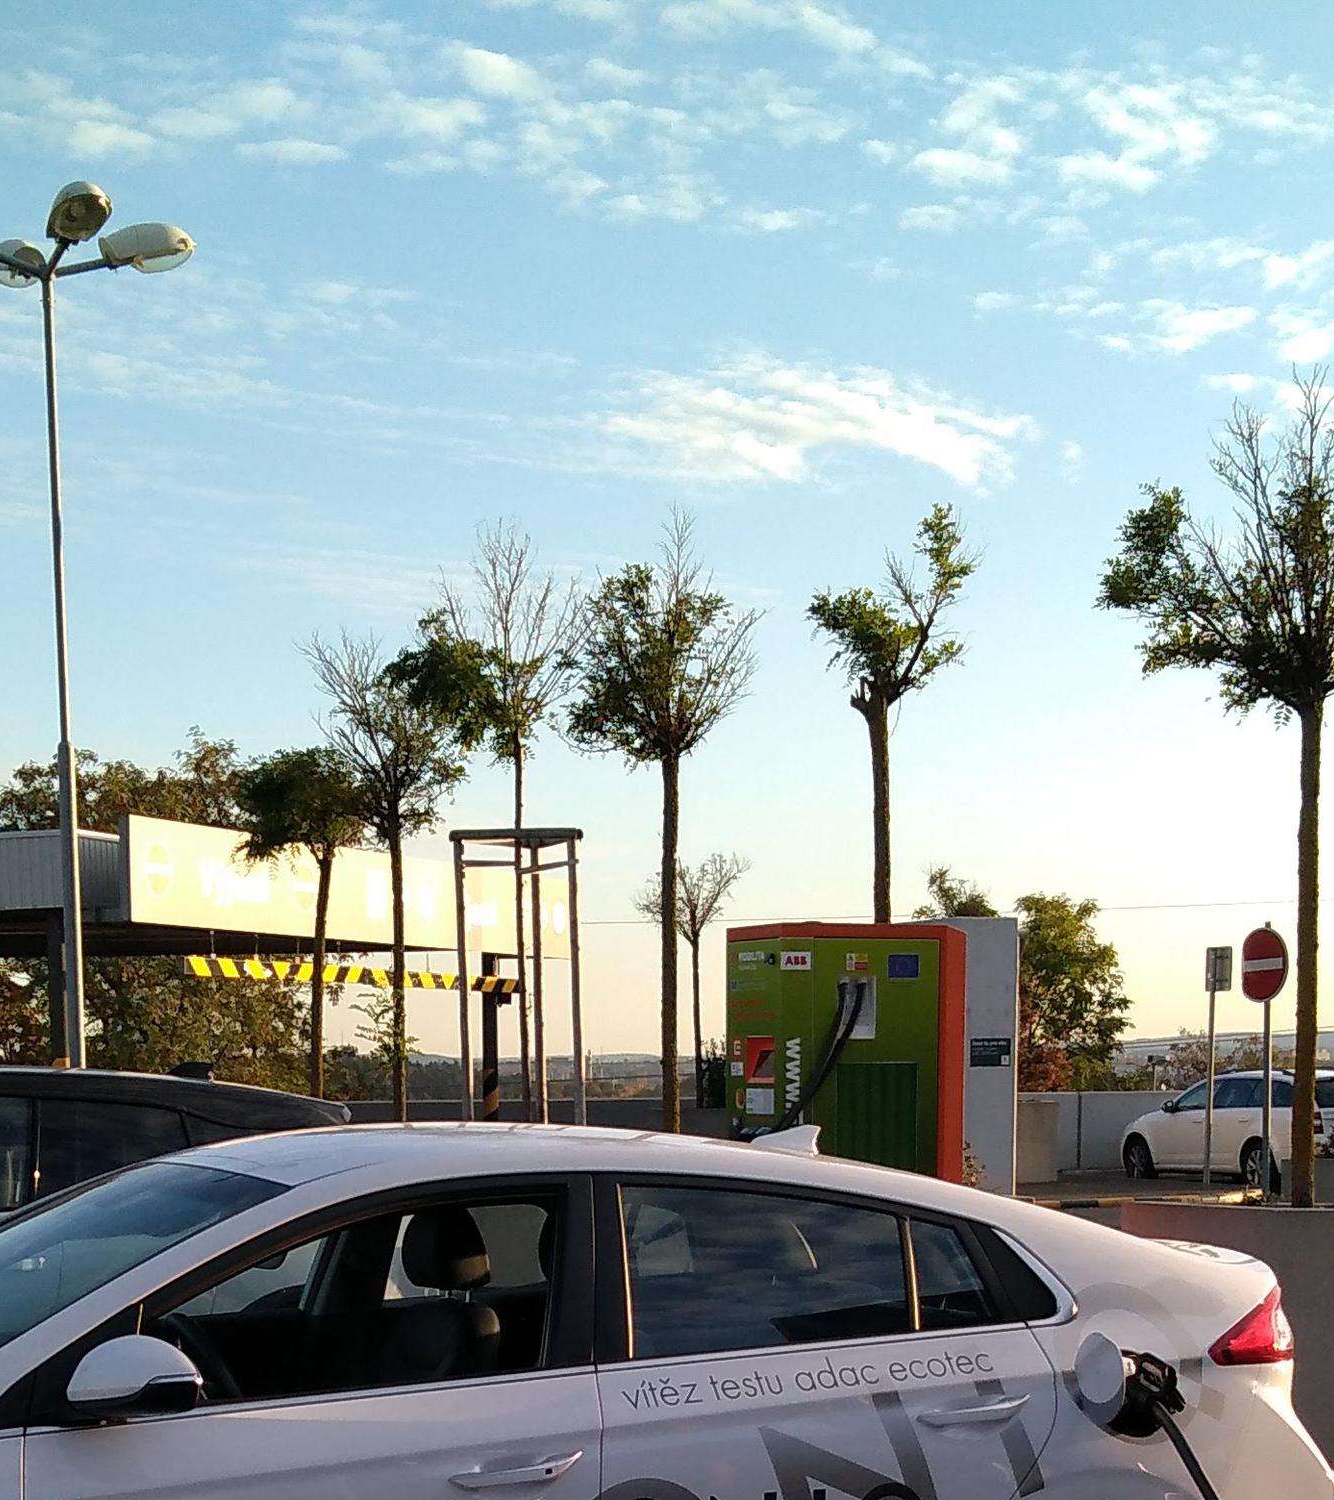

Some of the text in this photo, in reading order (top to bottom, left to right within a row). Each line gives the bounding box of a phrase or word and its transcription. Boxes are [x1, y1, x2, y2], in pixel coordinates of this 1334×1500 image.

[785, 956, 807, 966] ABB
[622, 1350, 995, 1409] vítěz testu adac ecotec
